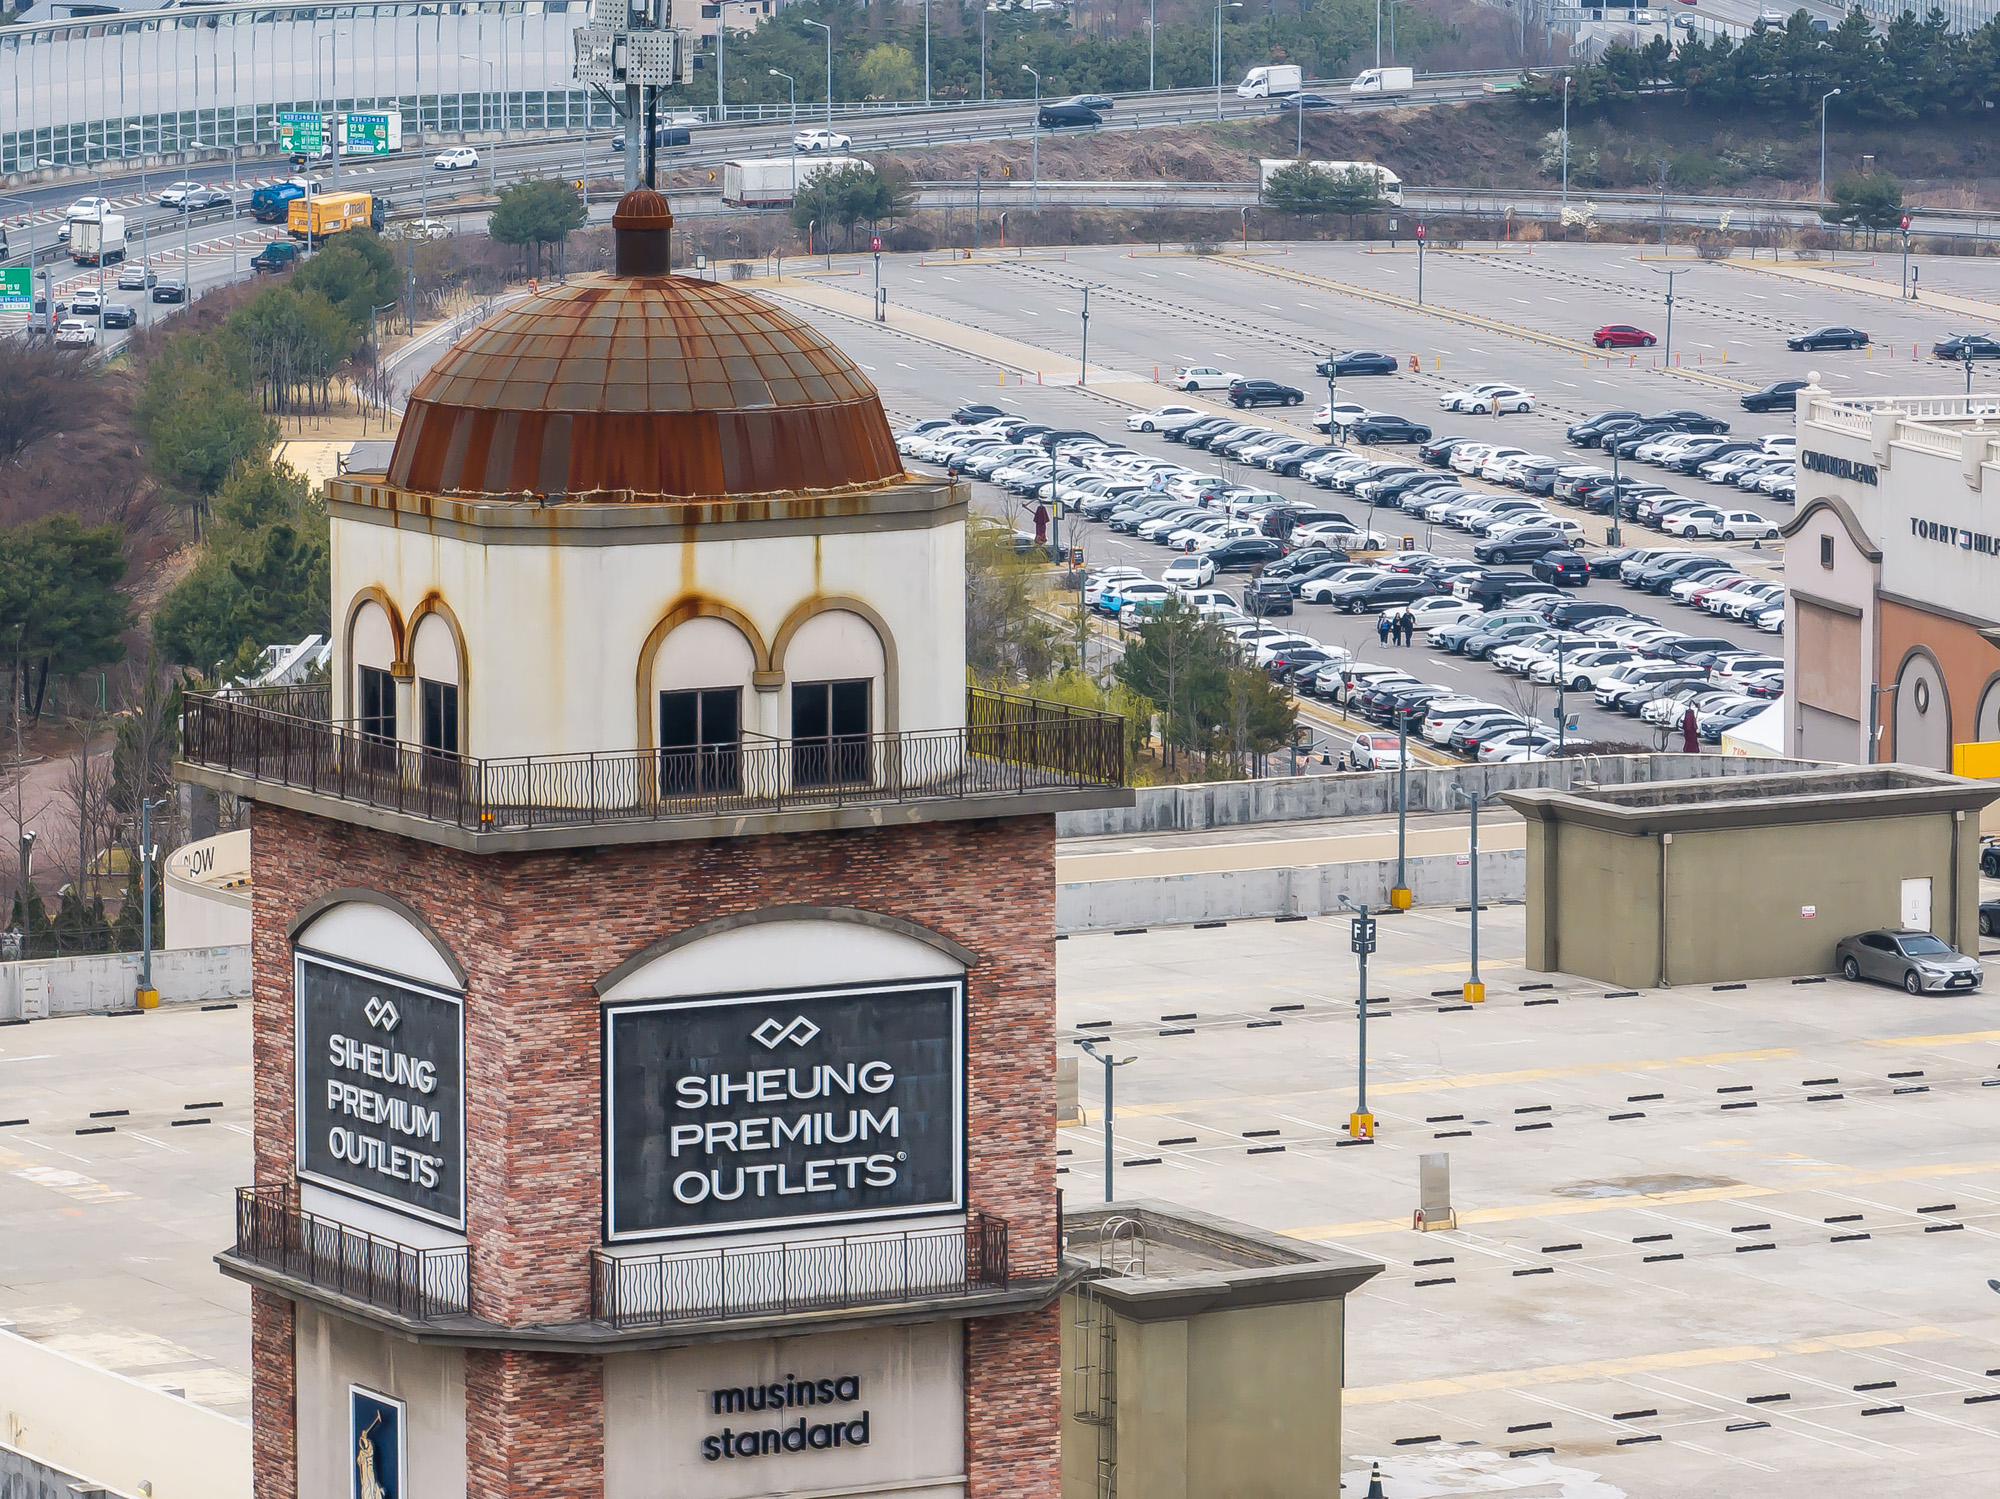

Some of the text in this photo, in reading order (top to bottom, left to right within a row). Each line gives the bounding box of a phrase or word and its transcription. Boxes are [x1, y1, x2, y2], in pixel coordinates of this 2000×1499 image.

[343, 201, 367, 217] emart
[1910, 517, 1958, 545] TOMMY
[1353, 923, 1362, 939] F
[1366, 923, 1374, 939] F
[329, 1033, 438, 1094] SIHEUNG
[675, 1060, 895, 1109] SIHEUNG
[327, 1079, 441, 1143] PREMIUM
[670, 1106, 899, 1157] PREMIUM
[712, 1373, 862, 1415] musinsa
[702, 1410, 872, 1462] standard
